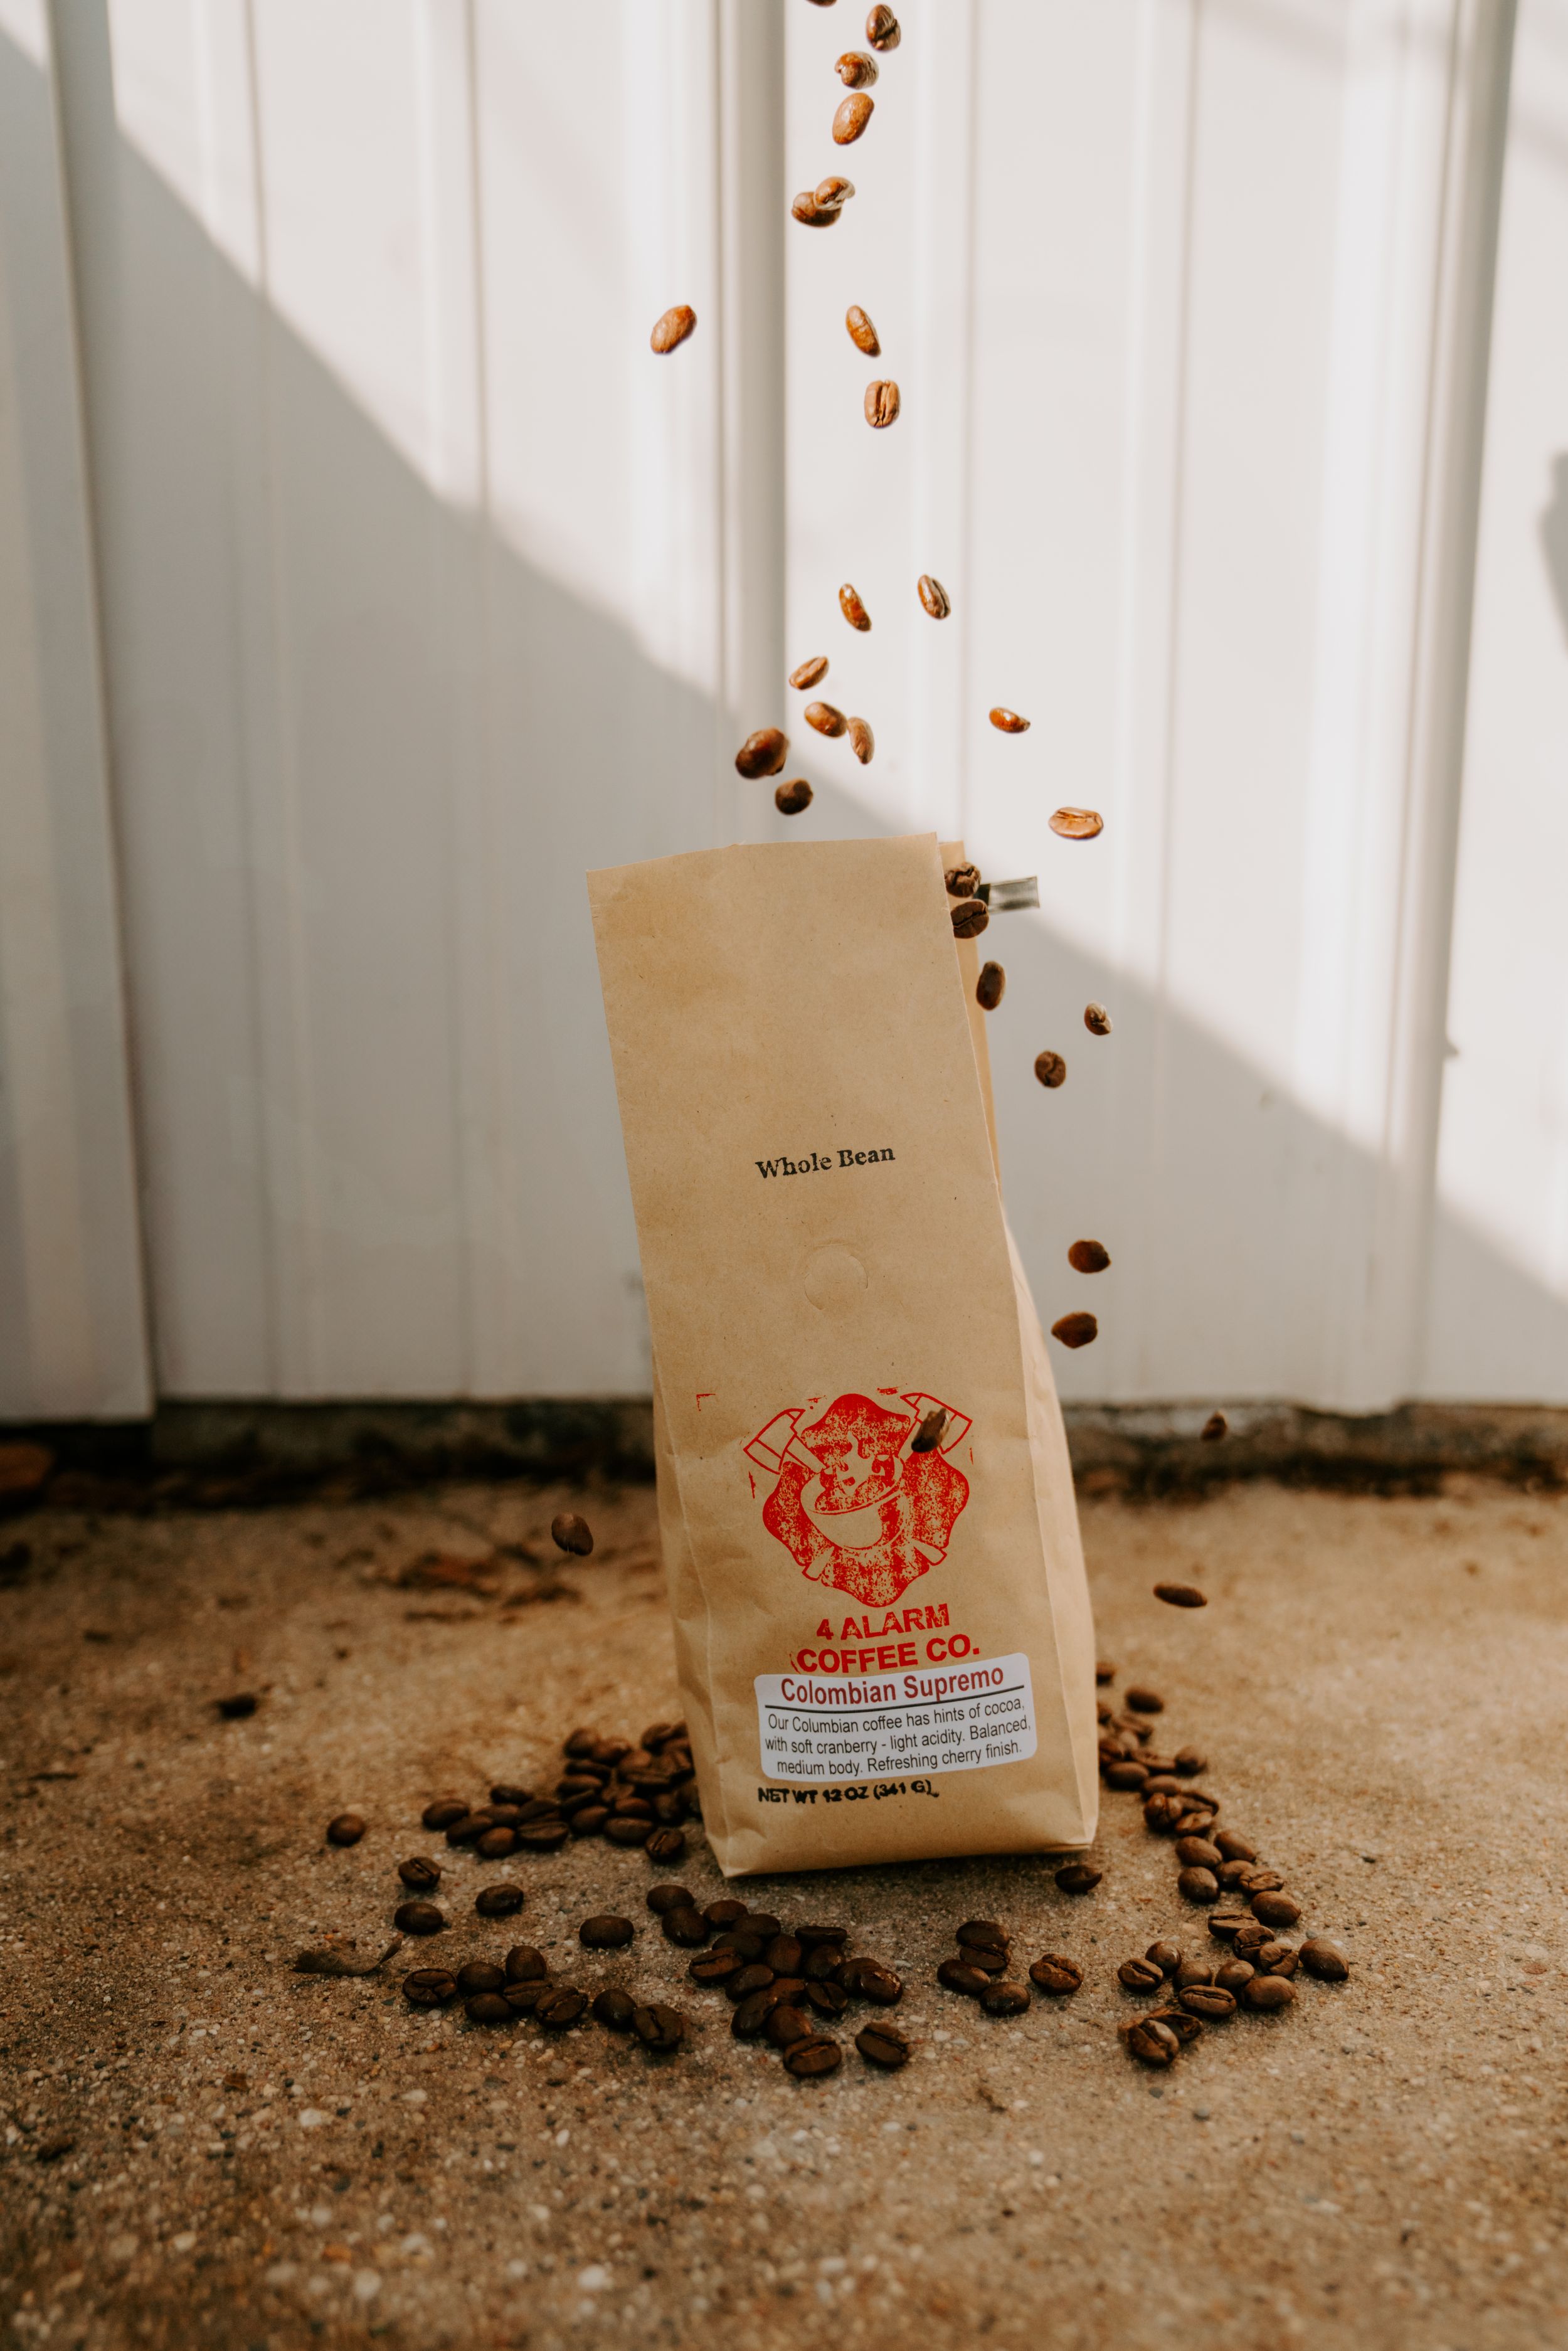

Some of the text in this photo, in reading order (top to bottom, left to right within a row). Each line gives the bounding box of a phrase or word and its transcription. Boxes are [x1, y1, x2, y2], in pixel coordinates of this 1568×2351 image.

[755, 1148, 895, 1179] Whole Bean
[816, 1603, 950, 1640] 4 ALARM
[797, 1634, 980, 1674] COFFEE CO.
[781, 1667, 1004, 1705] Colombian Supremo
[768, 1698, 1024, 1733] Our Columbian coffee has hints of cocoa,
[765, 1736, 787, 1751] with
[792, 1739, 813, 1754] soft
[817, 1739, 877, 1754] cranberry
[890, 1734, 918, 1752] light
[922, 1728, 965, 1746] acidity.
[970, 1715, 1030, 1739] Balanced,
[778, 1739, 1022, 1776] medium body. Refreshing cherry finish.
[758, 1788, 790, 1803] NET
[793, 1790, 818, 1803] WT
[822, 1789, 842, 1803] 12
[844, 1786, 869, 1800] OZ
[873, 1782, 906, 1800] (341
